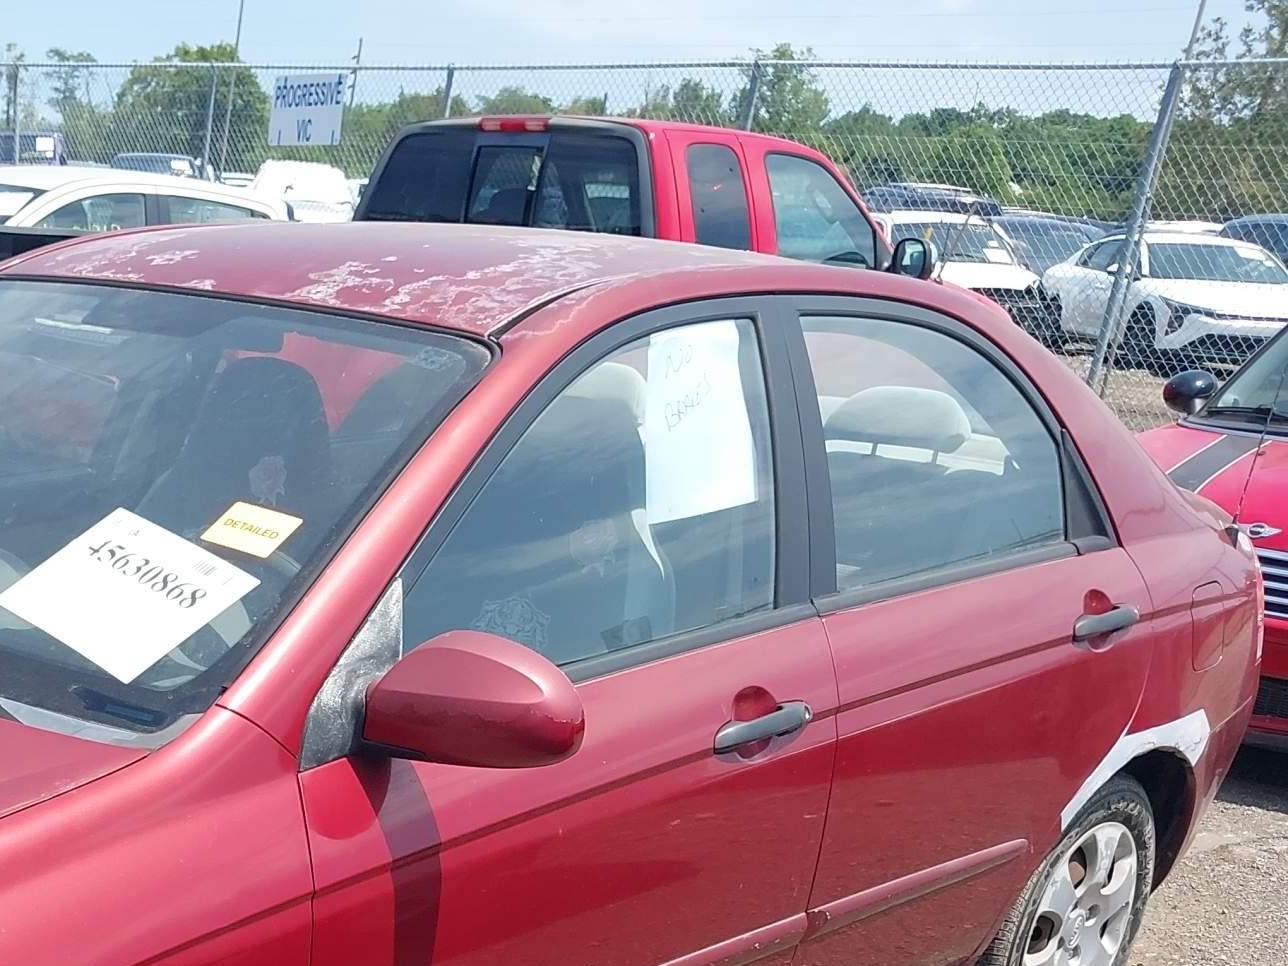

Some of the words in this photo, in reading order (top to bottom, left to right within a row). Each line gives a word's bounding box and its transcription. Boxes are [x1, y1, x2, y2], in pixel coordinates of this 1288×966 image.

[274, 81, 341, 108] PROGRESSIVE
[296, 119, 313, 142] VIC
[223, 518, 280, 539] DETAILED
[88, 539, 208, 609] 45630868
